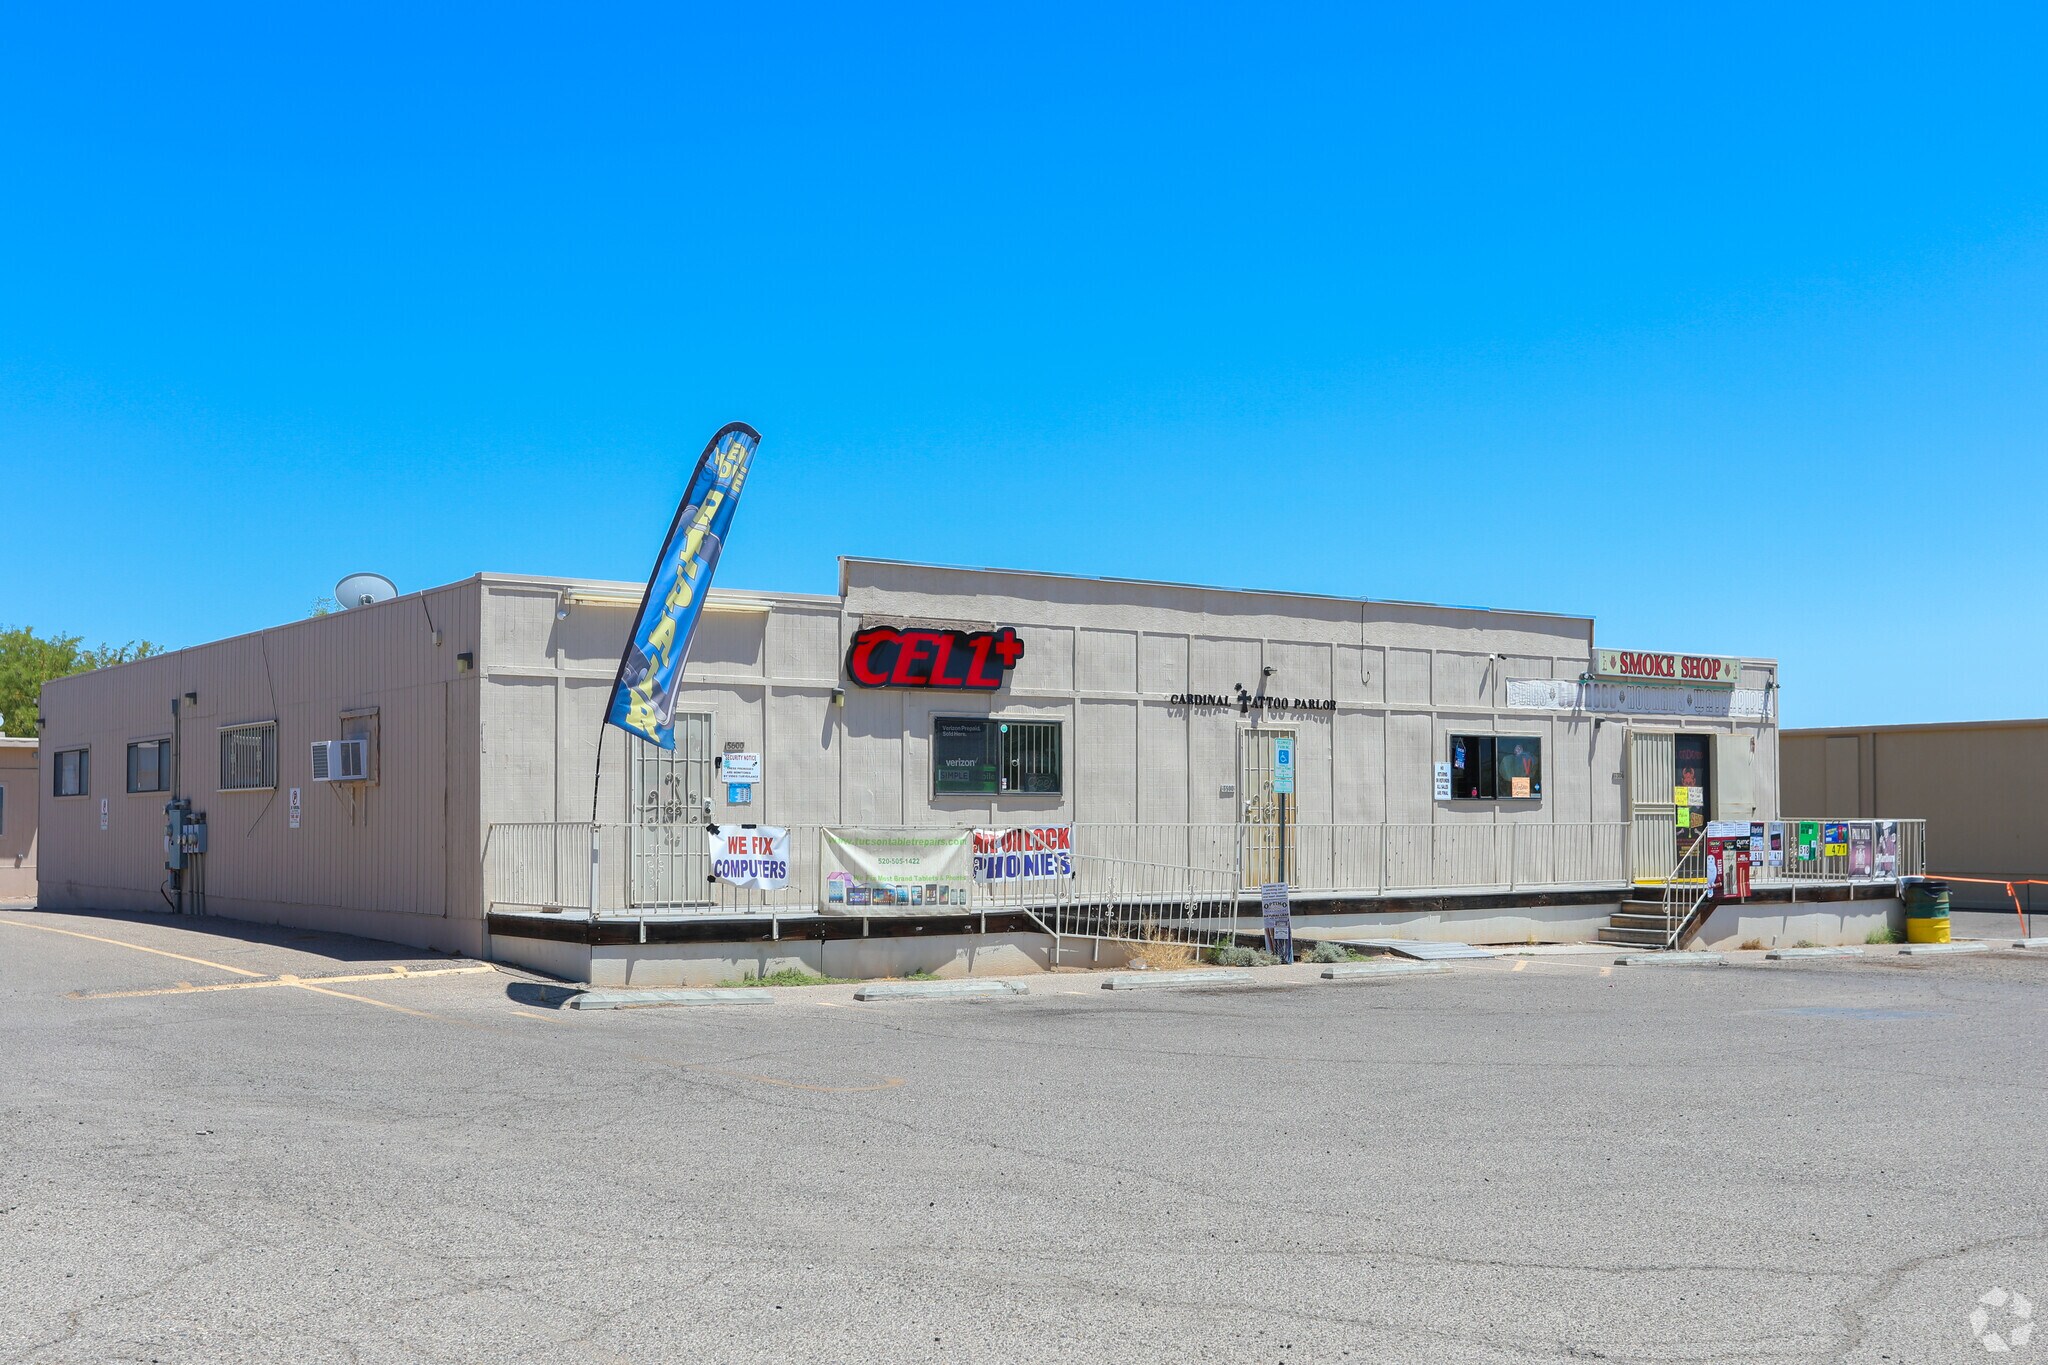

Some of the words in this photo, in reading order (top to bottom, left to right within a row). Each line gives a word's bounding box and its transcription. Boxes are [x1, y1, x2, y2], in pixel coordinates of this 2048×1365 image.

[1619, 651, 1675, 678] SMOKE
[1681, 655, 1722, 680] SHOP
[1170, 693, 1232, 707] CARDINAL
[1293, 698, 1337, 711] PARLOR
[1627, 685, 1685, 711] HOOKAHS
[945, 758, 975, 767] verizon
[940, 771, 968, 780] SIMPLE
[728, 836, 748, 855] WE
[752, 836, 774, 855] FIX
[1831, 845, 1846, 854] 471
[714, 859, 786, 879] COMPUTERS
[973, 852, 1071, 879] PHONES
[1264, 901, 1288, 910] OPTIMO
